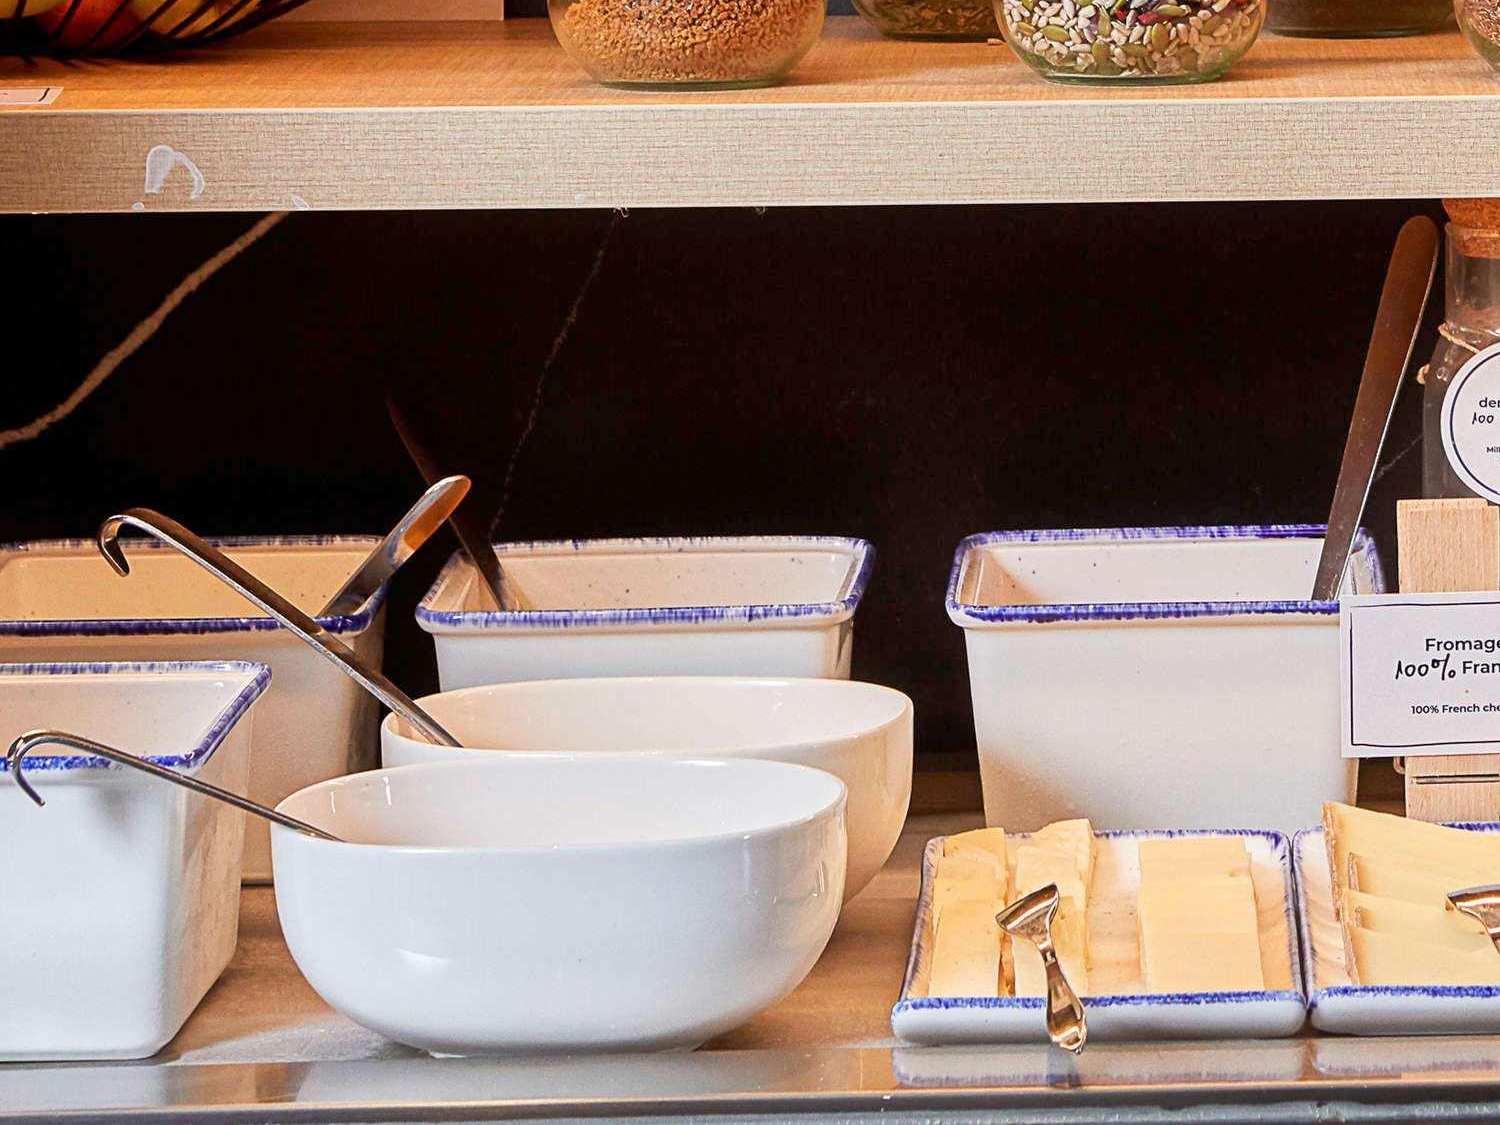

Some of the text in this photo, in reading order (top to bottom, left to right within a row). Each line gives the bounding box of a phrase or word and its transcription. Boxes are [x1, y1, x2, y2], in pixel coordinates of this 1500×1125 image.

[1472, 412, 1494, 425] 100
[1395, 653, 1456, 680] 100%
[1411, 704, 1439, 714] 100%
[1442, 703, 1480, 713] French
